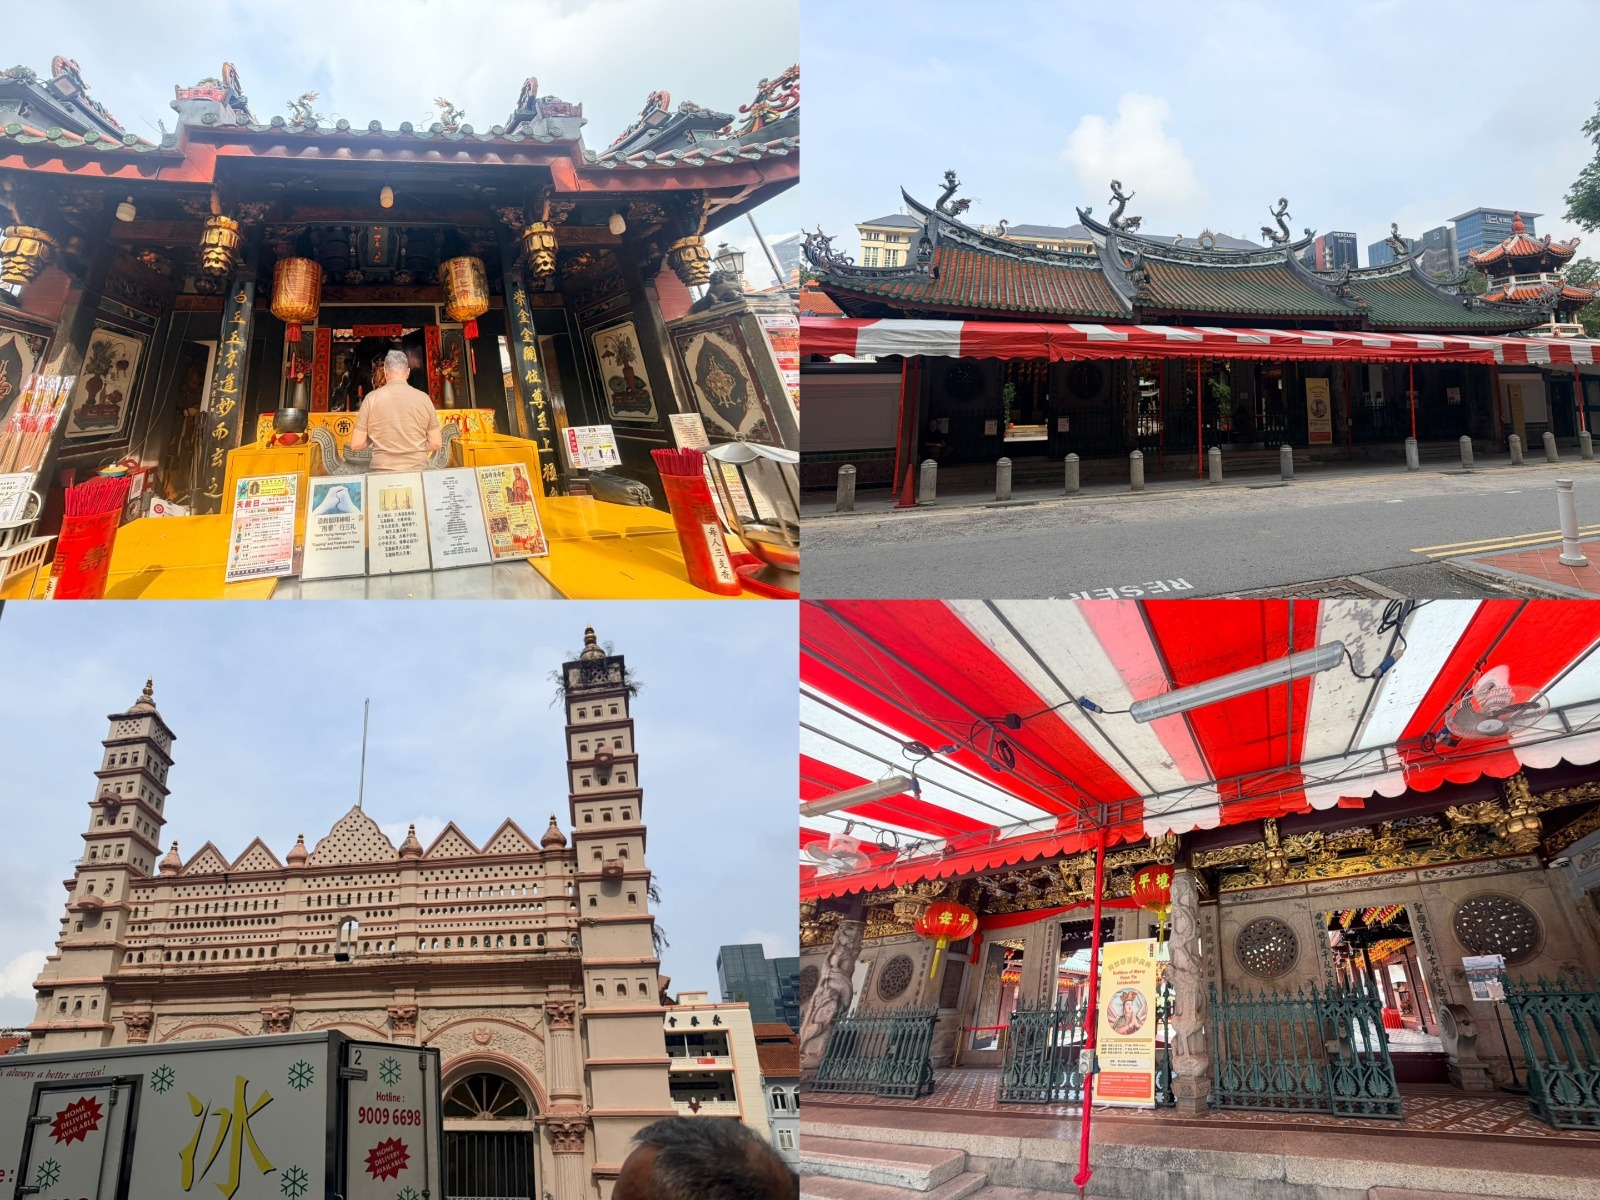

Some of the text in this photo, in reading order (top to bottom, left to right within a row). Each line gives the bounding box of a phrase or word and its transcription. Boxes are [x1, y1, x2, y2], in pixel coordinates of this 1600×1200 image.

[1047, 578, 1194, 600] RESER
[354, 1049, 362, 1065] 2
[6, 1068, 36, 1080] always
[45, 1069, 71, 1079] better
[72, 1065, 106, 1079] service!
[376, 1091, 401, 1103] Hotline
[60, 1111, 92, 1130] DELIVERY
[64, 1105, 86, 1120] HOME
[358, 1106, 421, 1127] 9009 6698
[61, 1118, 95, 1139] AVAILABLE
[179, 1074, 276, 1200] 冰
[374, 1150, 401, 1167] DELIVERY
[376, 1144, 395, 1157] HOME
[376, 1157, 405, 1175] AVAILABLE
